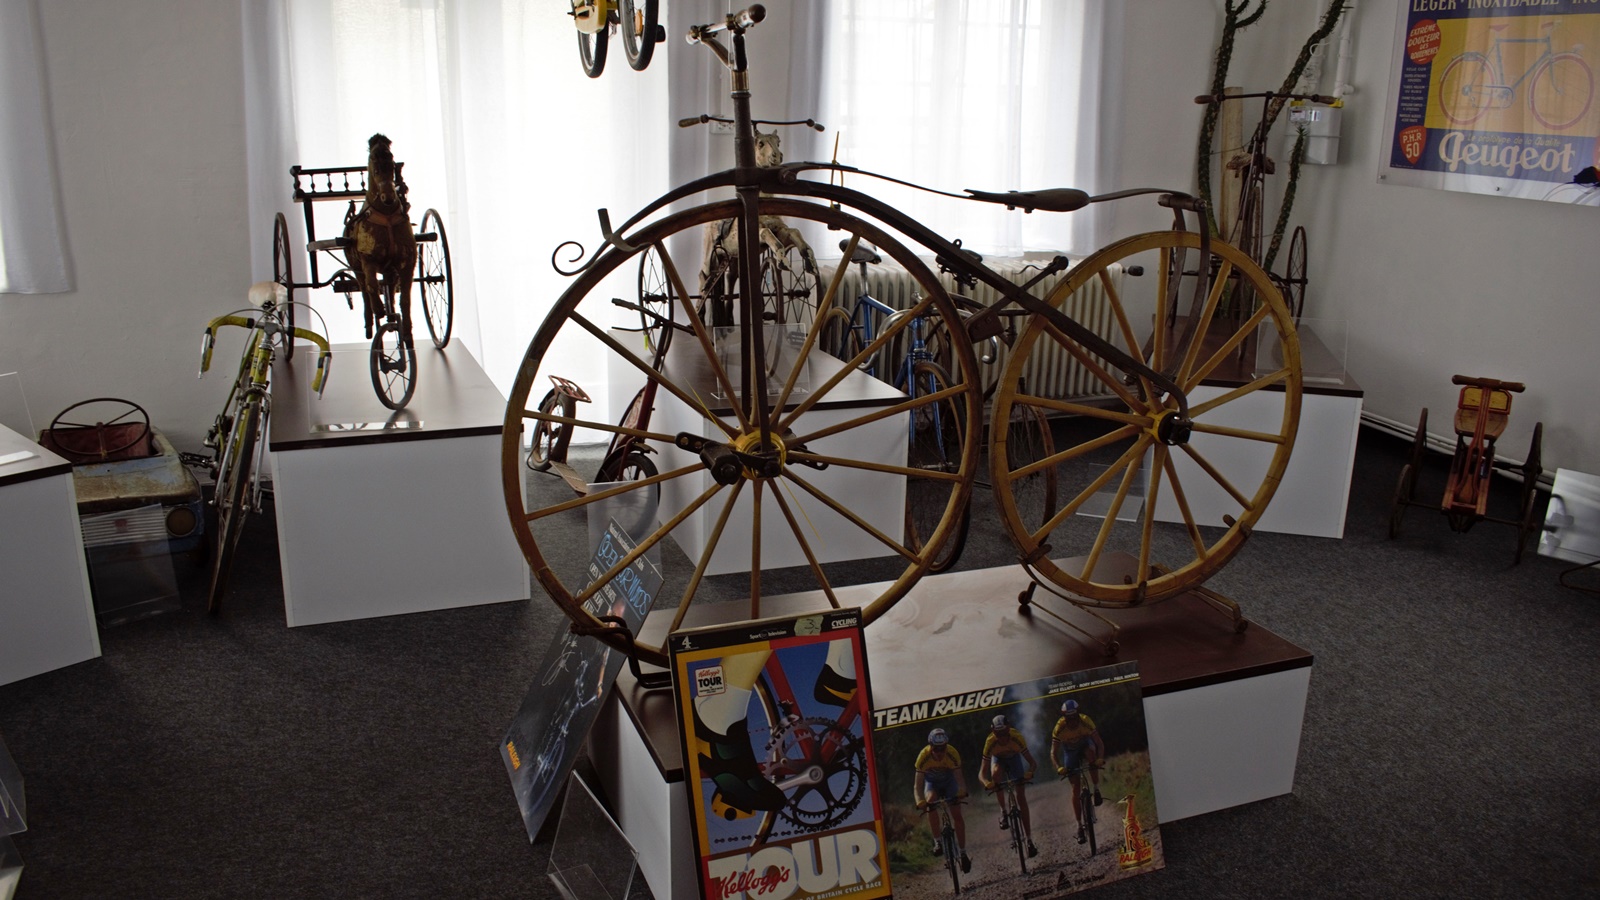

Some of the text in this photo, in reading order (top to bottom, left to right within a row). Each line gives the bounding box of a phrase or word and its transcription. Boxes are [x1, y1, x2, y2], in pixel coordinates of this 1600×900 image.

[1407, 31, 1440, 47] DOUCEUR
[1513, 135, 1523, 145] de
[1526, 136, 1532, 145] la
[1406, 142, 1420, 159] 50
[1439, 131, 1576, 177] Peugeot
[831, 617, 857, 627] CYCLING
[681, 635, 692, 649] 4
[698, 676, 722, 688] TOUR
[873, 687, 1006, 728] TEAM RALEIGH
[506, 741, 521, 770] RALEIGH
[1119, 847, 1152, 864] RALEIGH
[707, 829, 882, 900] TOUR
[719, 866, 790, 899] Kellogg's
[817, 889, 843, 900] BRITAIN
[844, 885, 864, 894] CYCLE
[865, 881, 882, 889] RACE
